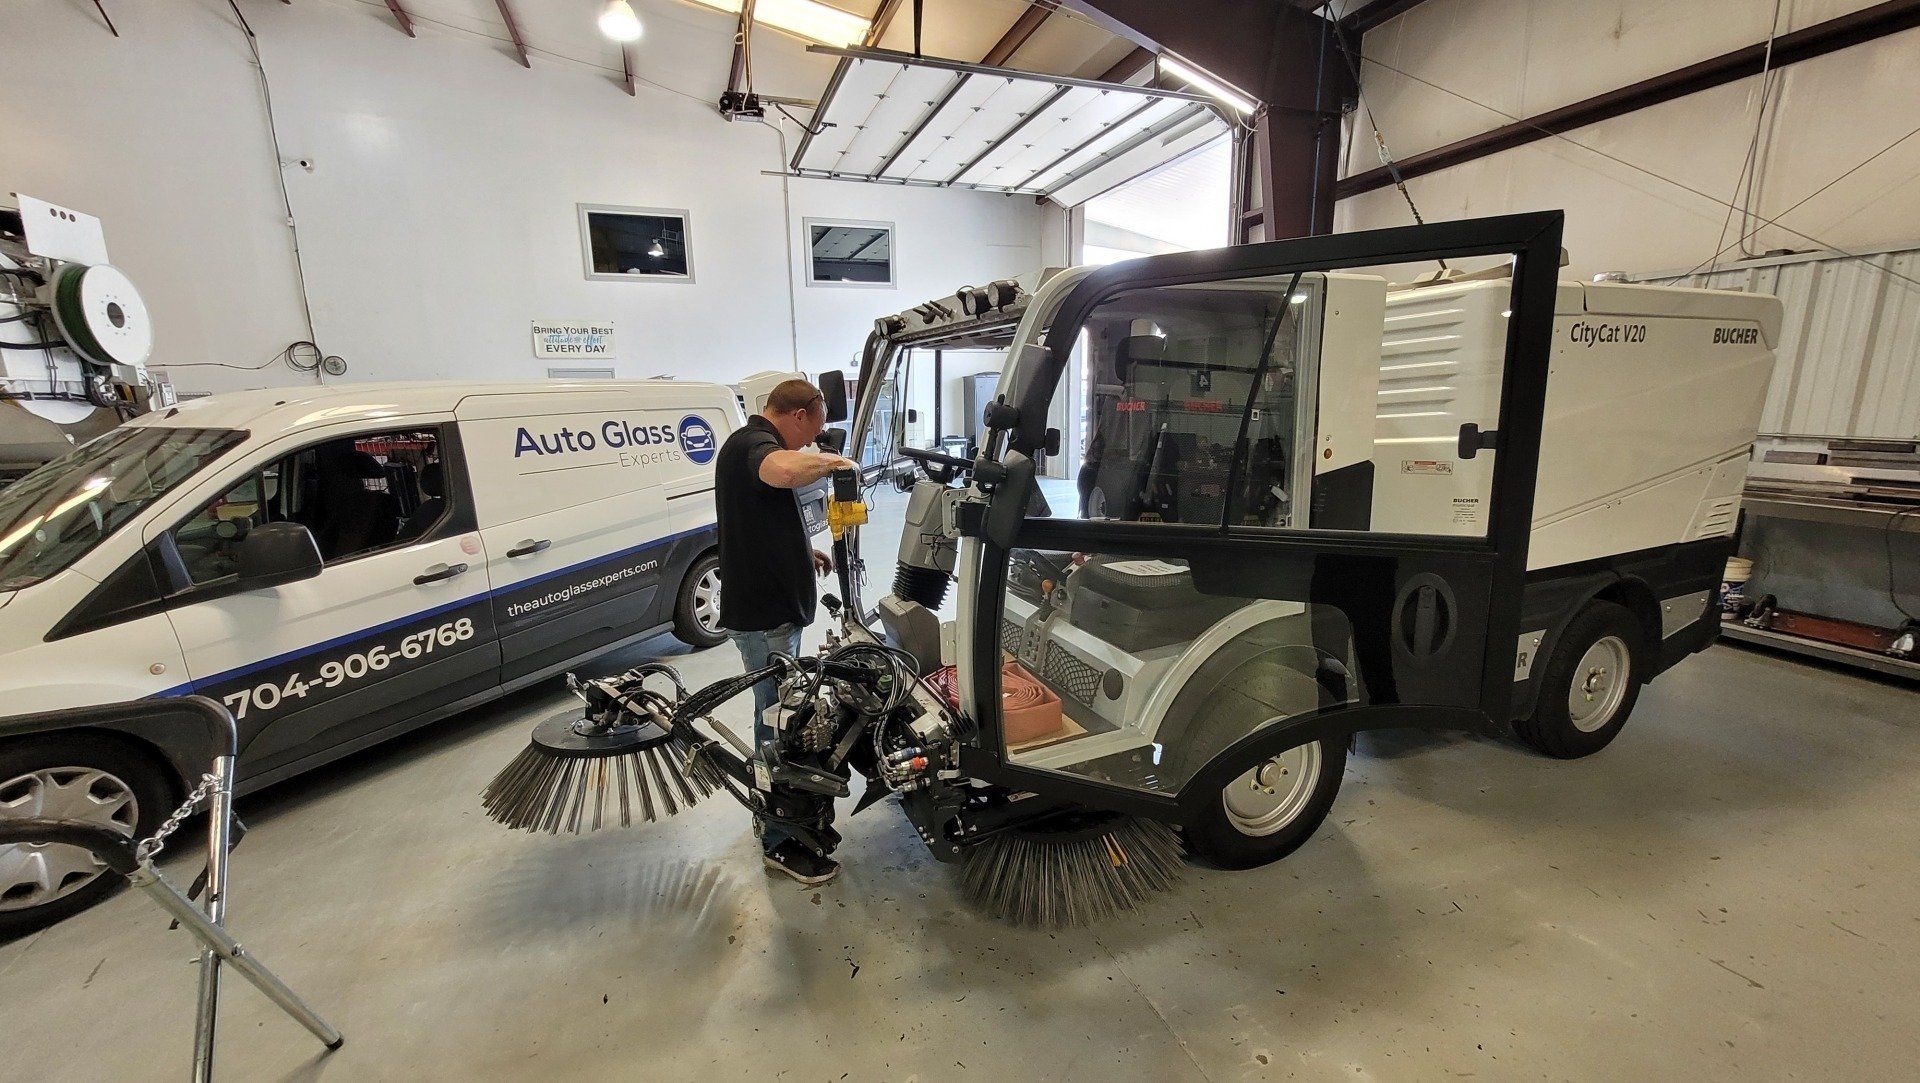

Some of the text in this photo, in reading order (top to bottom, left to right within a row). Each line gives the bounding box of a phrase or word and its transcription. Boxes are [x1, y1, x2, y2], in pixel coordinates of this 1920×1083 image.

[533, 326, 614, 335] BRING YOUR BEST
[1570, 321, 1647, 348] CityCat V20
[1713, 327, 1759, 344] BUCHER
[546, 344, 607, 353] EVERY DAY
[513, 420, 676, 458] Auto Glass
[618, 449, 681, 468] Experts
[507, 558, 658, 618] theautoglassexperts.com
[223, 617, 475, 720] 704-906-6768
